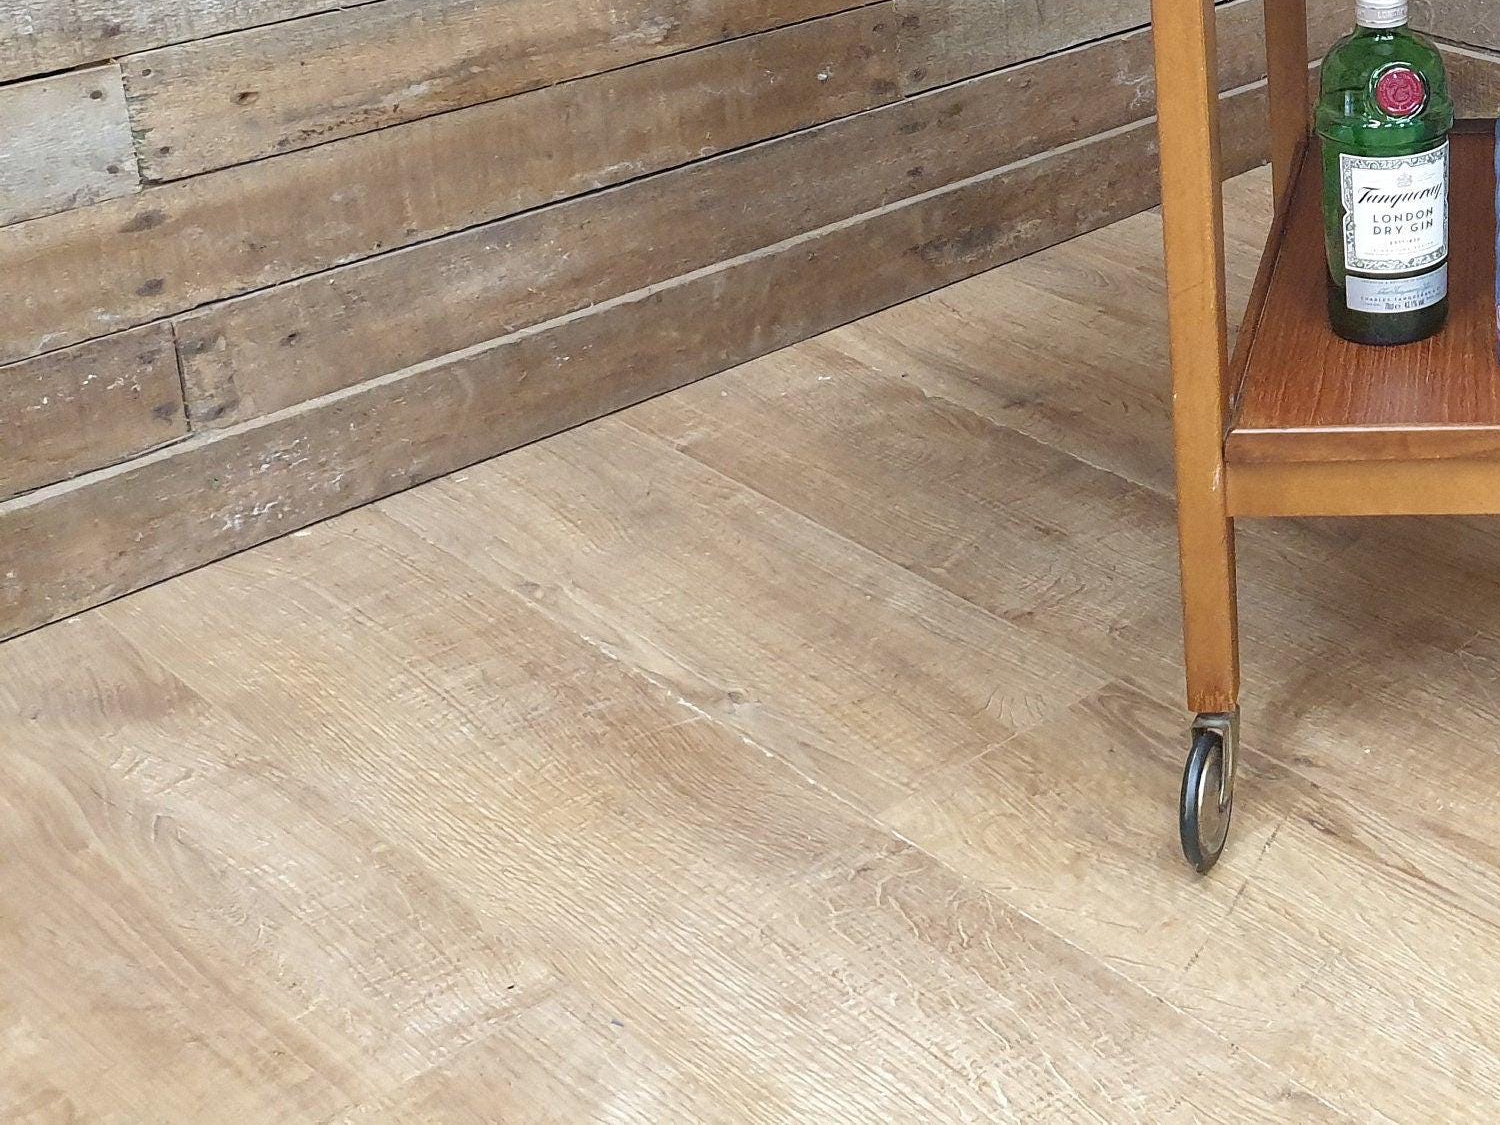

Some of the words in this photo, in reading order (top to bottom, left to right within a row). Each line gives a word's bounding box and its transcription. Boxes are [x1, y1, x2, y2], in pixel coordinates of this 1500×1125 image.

[1357, 182, 1443, 209] Tanqueray
[1373, 207, 1433, 224] LONDON
[1373, 225, 1403, 236] DRY
[1410, 218, 1433, 233] GIN
